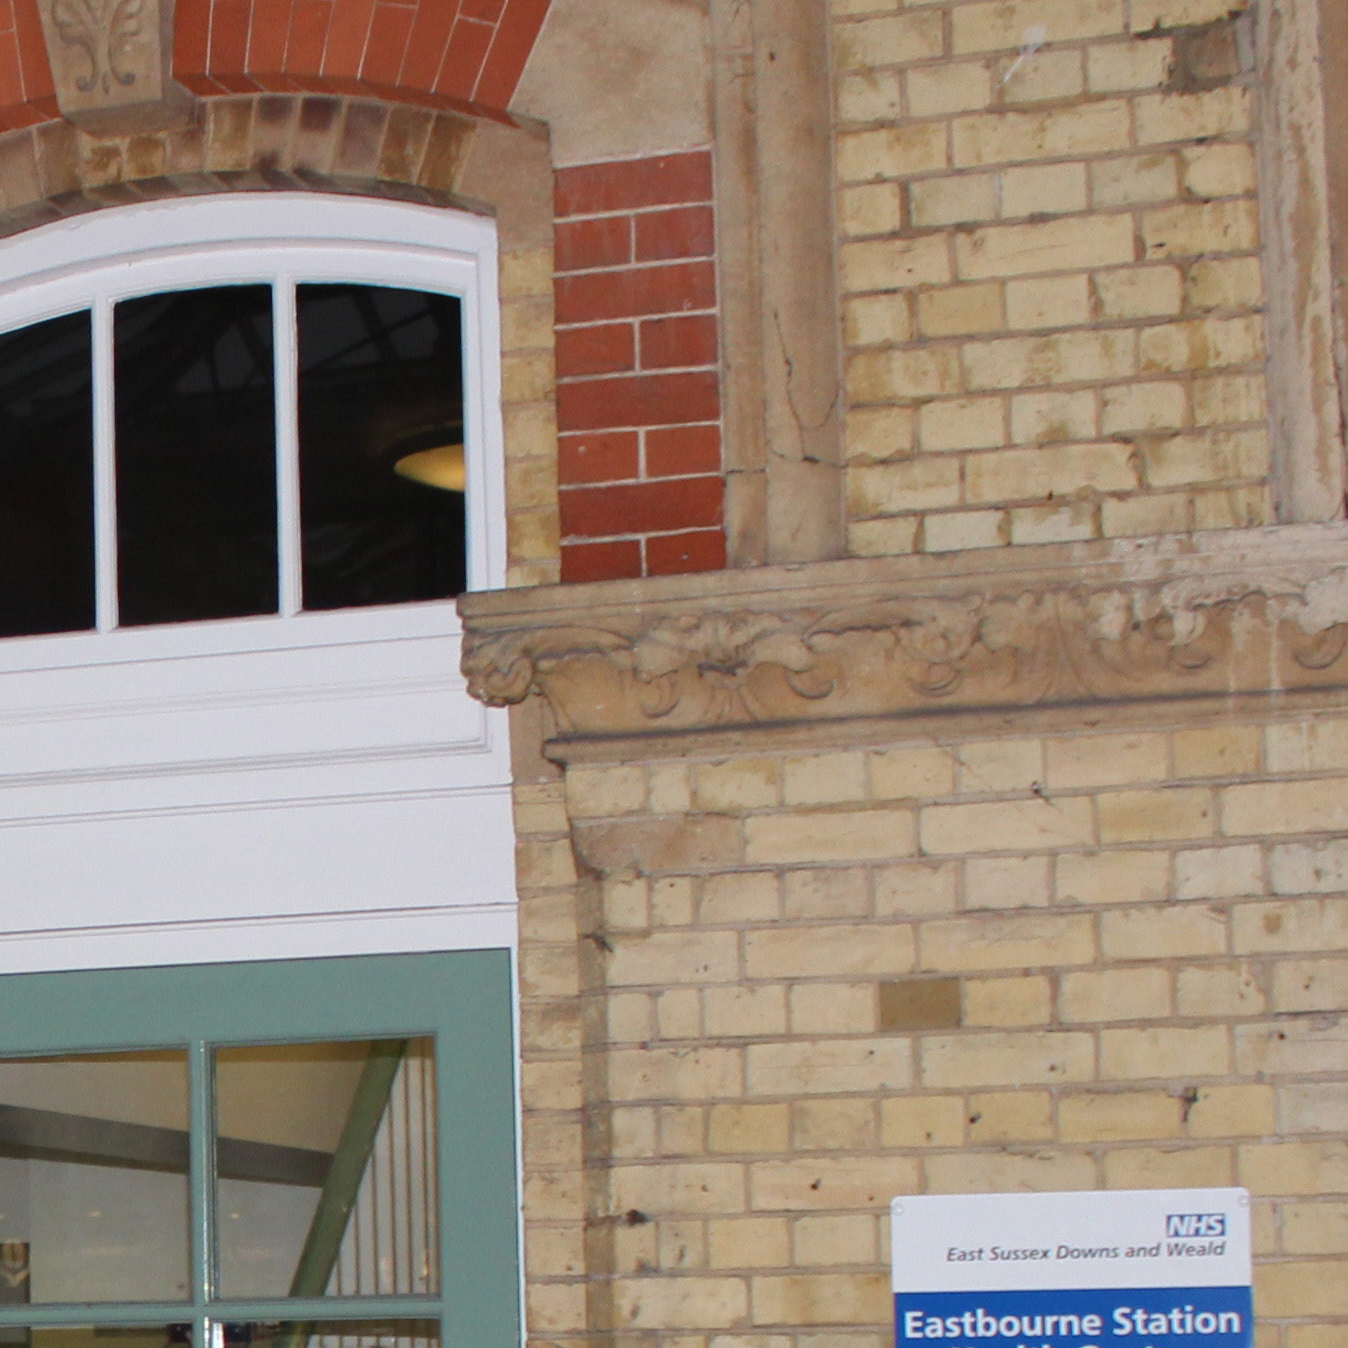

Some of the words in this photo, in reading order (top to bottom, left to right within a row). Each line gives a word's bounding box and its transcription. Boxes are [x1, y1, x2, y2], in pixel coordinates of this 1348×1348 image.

[1167, 1213, 1224, 1237] NHS
[946, 1247, 985, 1262] East
[989, 1246, 1051, 1261] Sussex
[1055, 1245, 1120, 1259] Downs
[1124, 1242, 1161, 1258] and
[1167, 1241, 1226, 1257] Weald
[905, 1308, 1103, 1338] Eastbourne
[1113, 1304, 1242, 1335] Station
